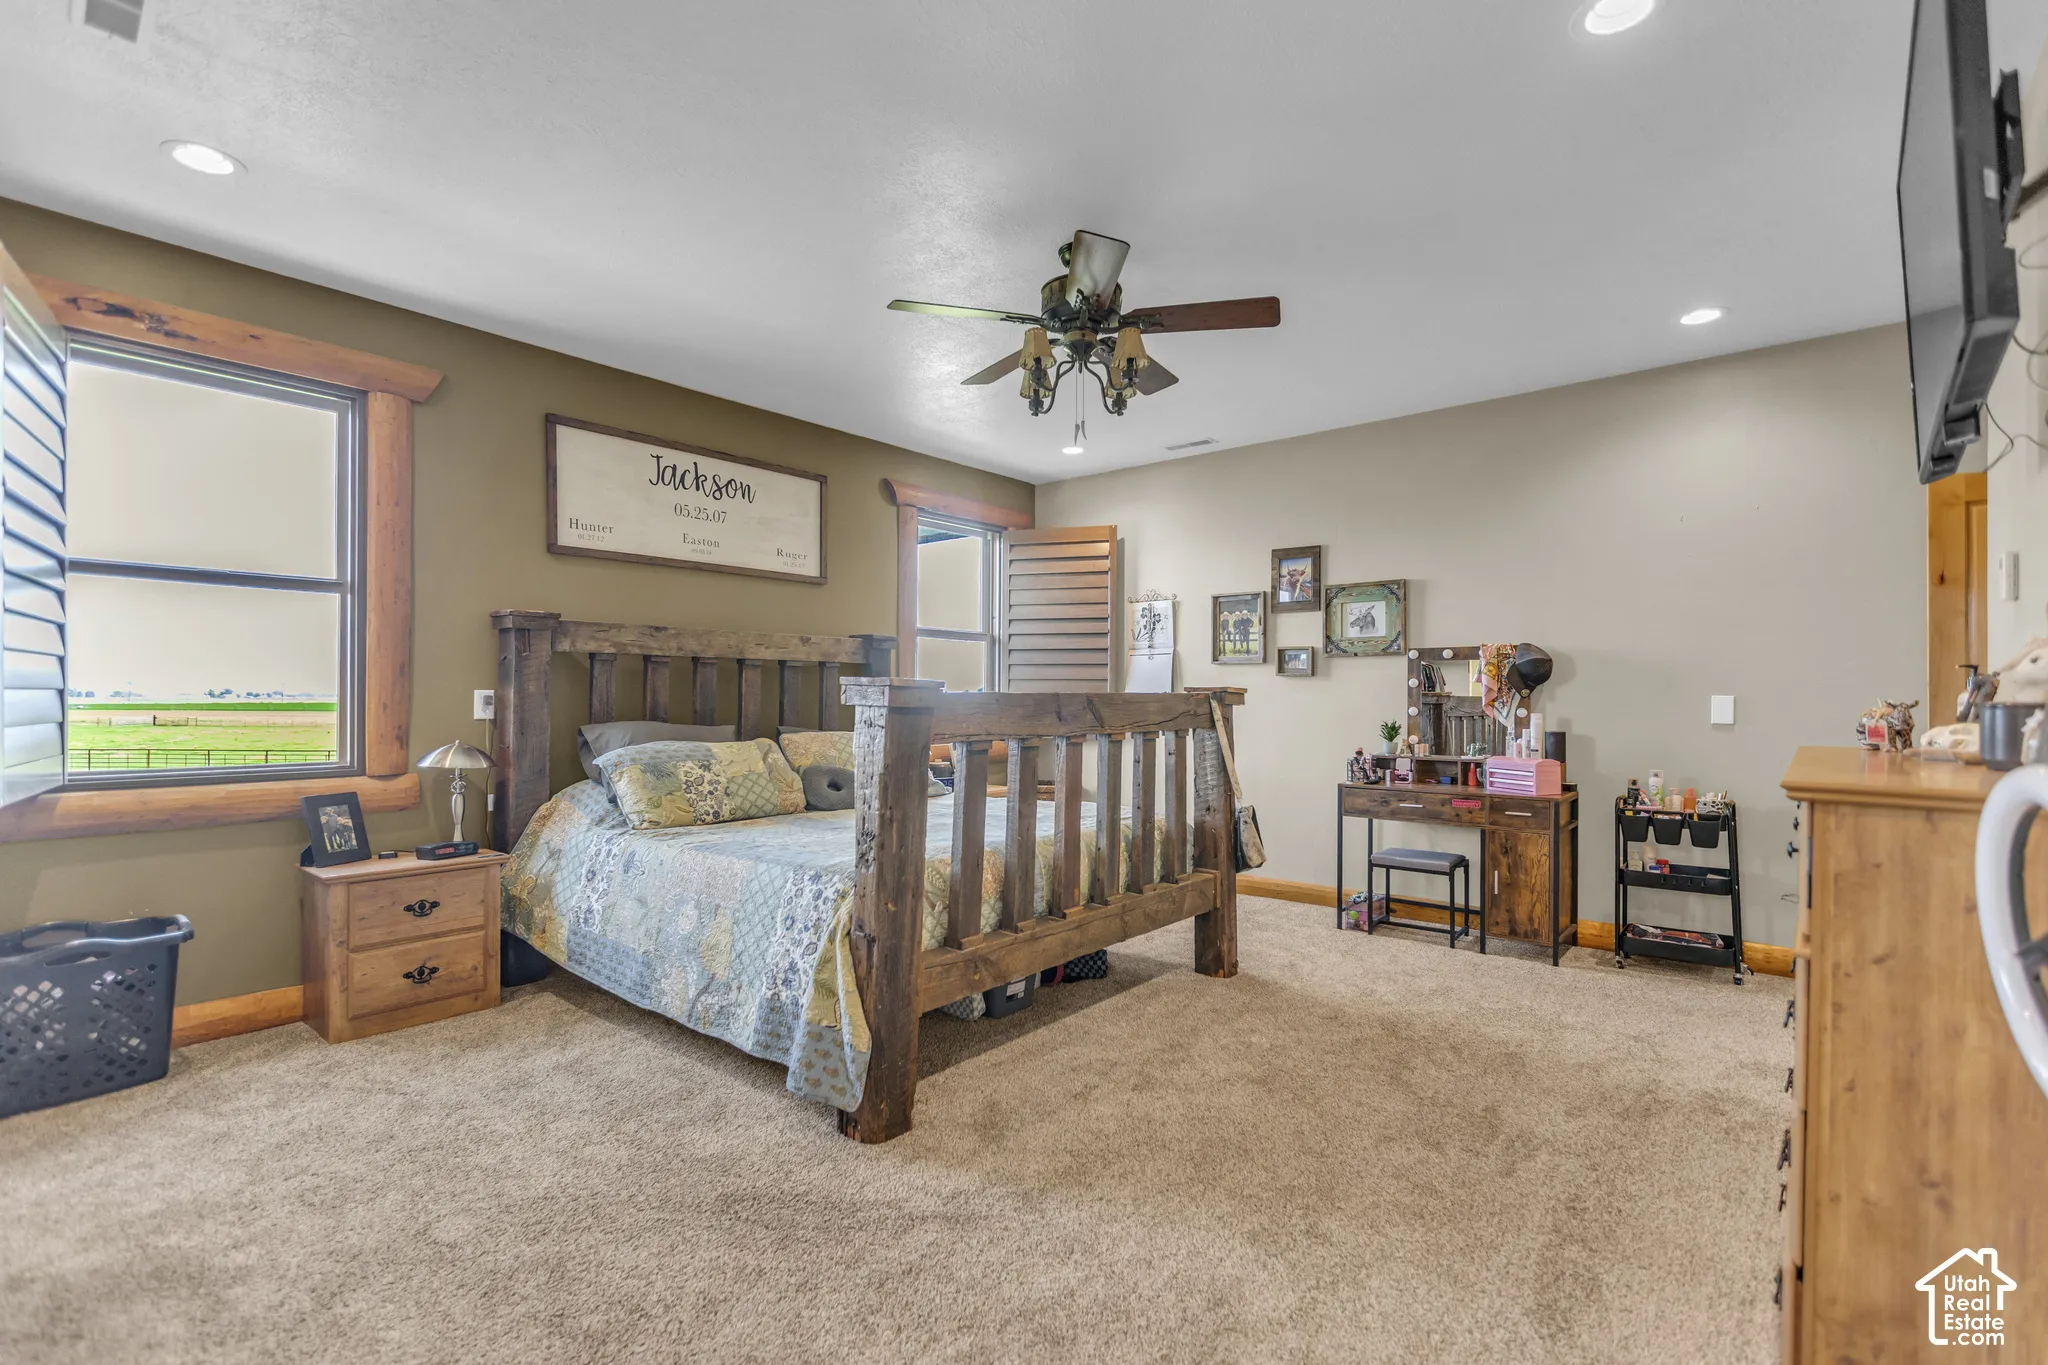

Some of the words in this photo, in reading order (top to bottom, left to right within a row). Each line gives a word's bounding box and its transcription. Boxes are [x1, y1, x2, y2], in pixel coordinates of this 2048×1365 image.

[649, 453, 756, 504] Jackson
[674, 502, 727, 524] 05.25.07
[568, 517, 614, 534] Hunter
[682, 532, 720, 548] Easton
[776, 547, 807, 561] Ruger
